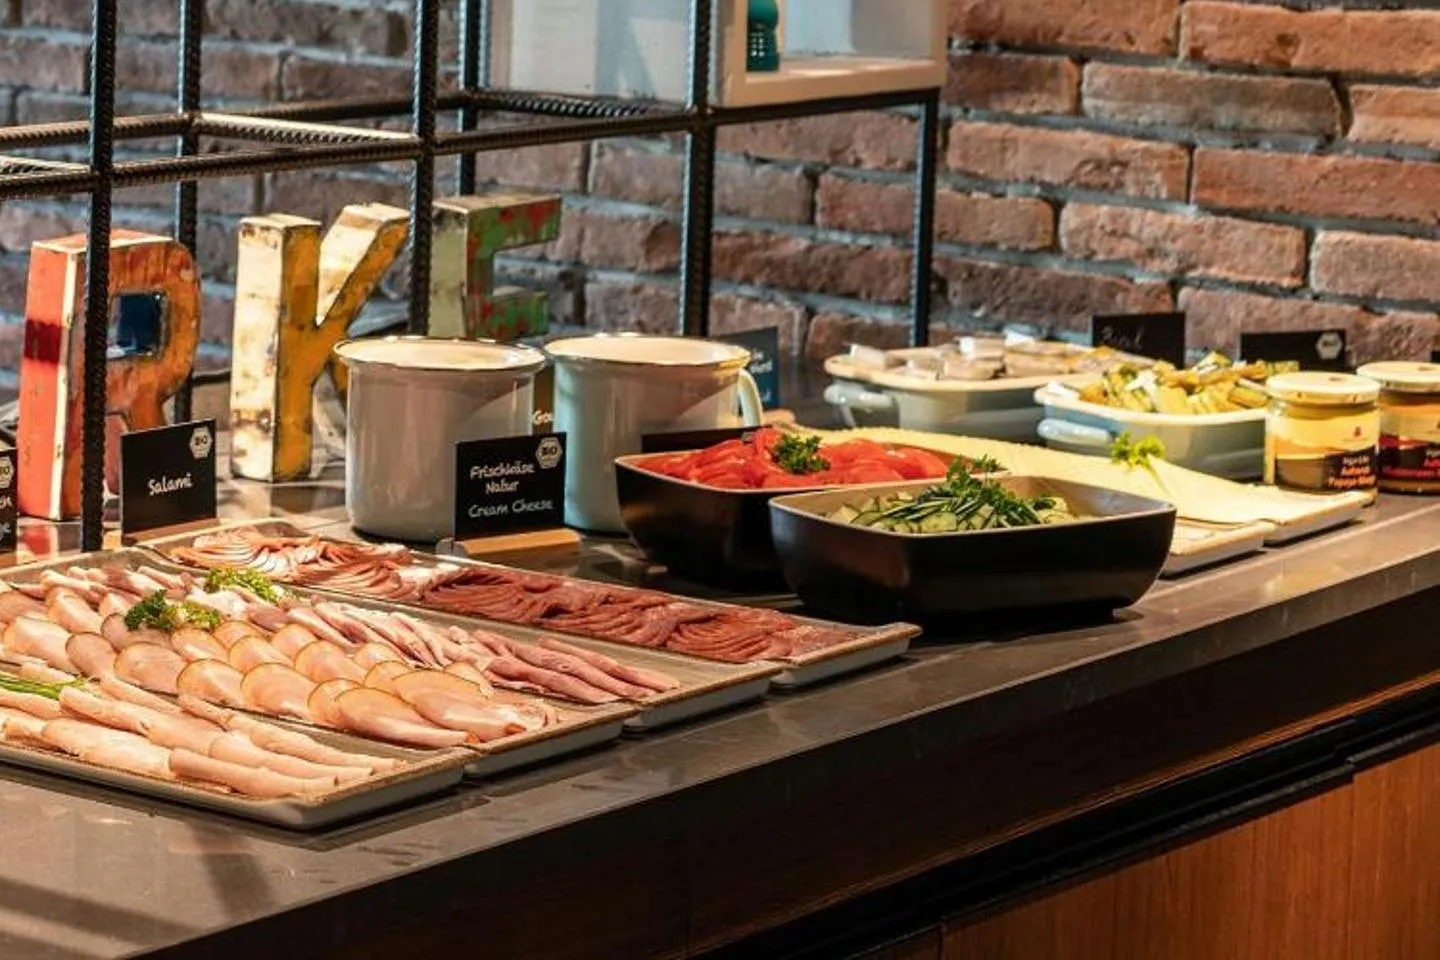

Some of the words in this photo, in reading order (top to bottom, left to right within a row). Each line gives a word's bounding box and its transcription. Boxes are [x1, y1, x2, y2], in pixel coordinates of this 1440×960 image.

[147, 471, 194, 497] Salami
[467, 503, 509, 519] Cream
[511, 498, 554, 513] Cheese
